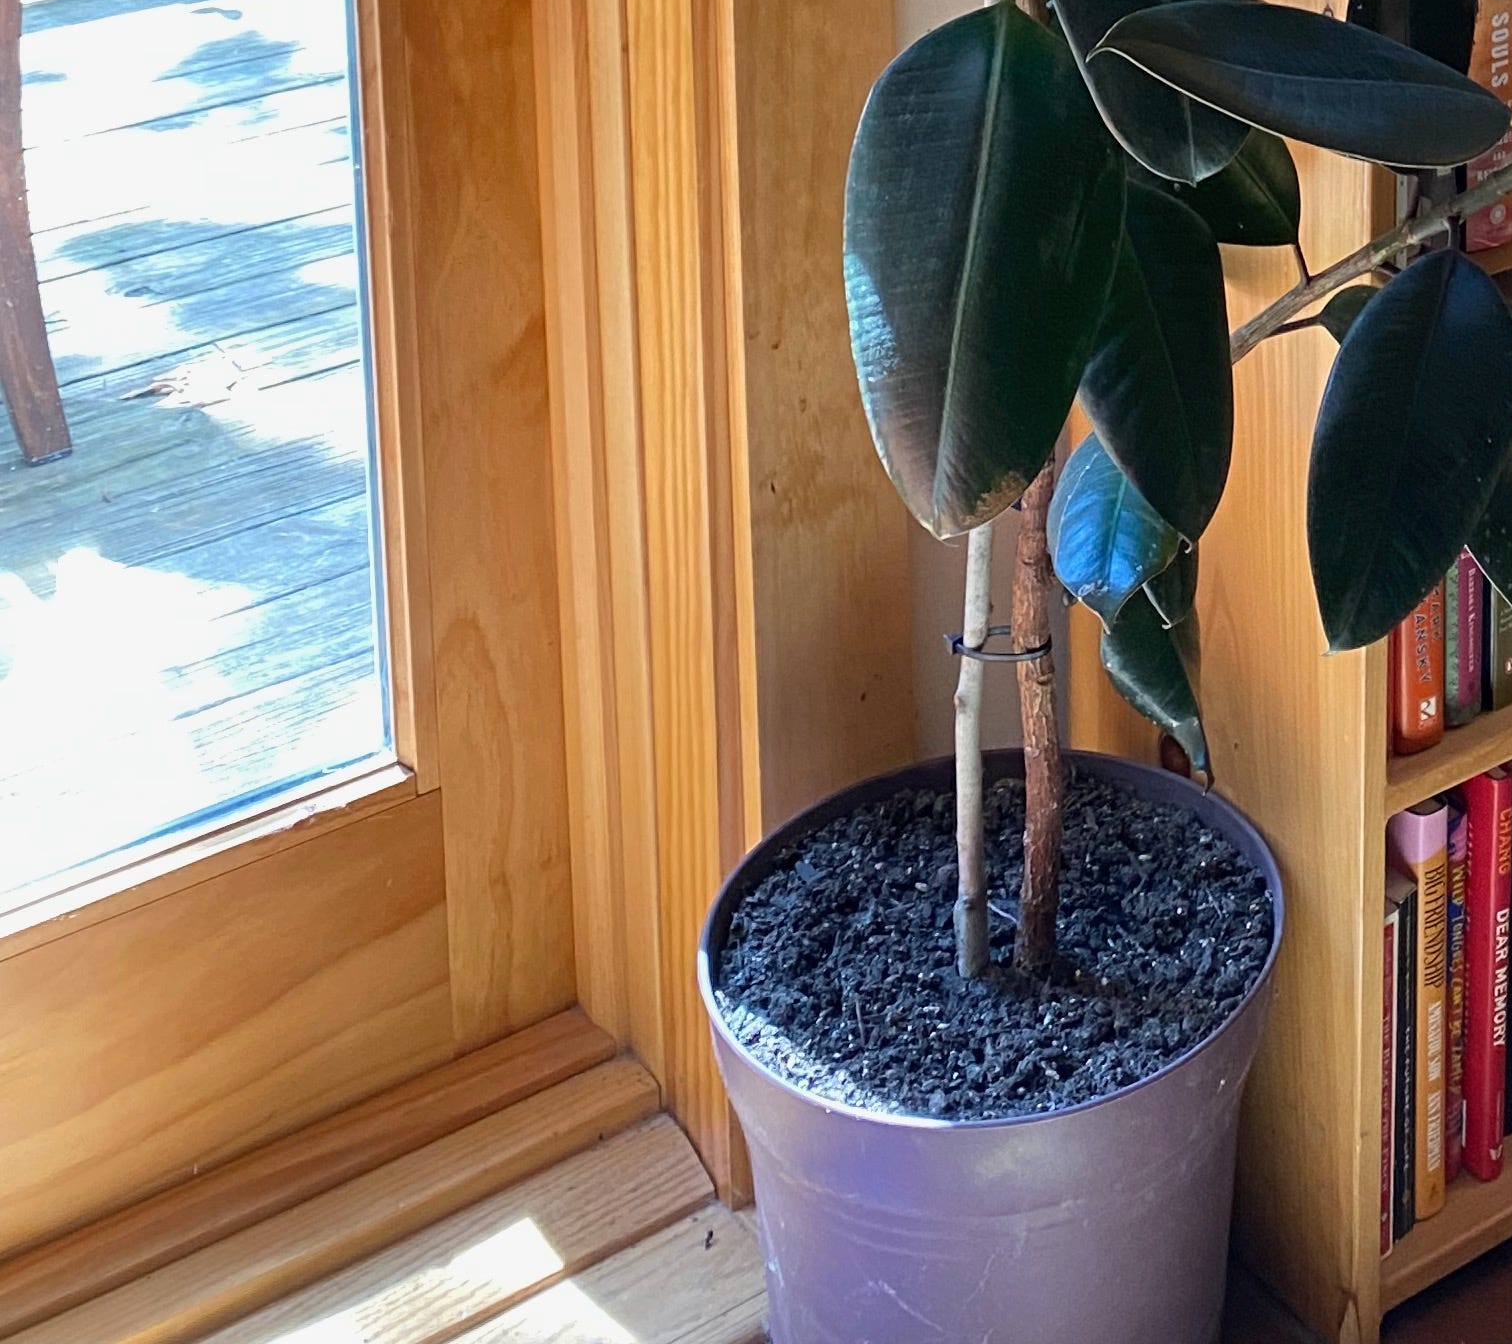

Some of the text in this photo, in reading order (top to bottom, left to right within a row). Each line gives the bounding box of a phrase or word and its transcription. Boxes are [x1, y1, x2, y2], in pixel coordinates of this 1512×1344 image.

[1491, 11, 1511, 88] SOULS
[1499, 807, 1512, 875] CHANG
[1423, 863, 1445, 899] BIG
[1451, 864, 1465, 907] WILD
[1423, 899, 1445, 989] FRIENDSHIP
[1449, 914, 1466, 973] TONGUES
[1492, 907, 1511, 1048] DEAR MEMORY
[1449, 1021, 1464, 1040] BE
